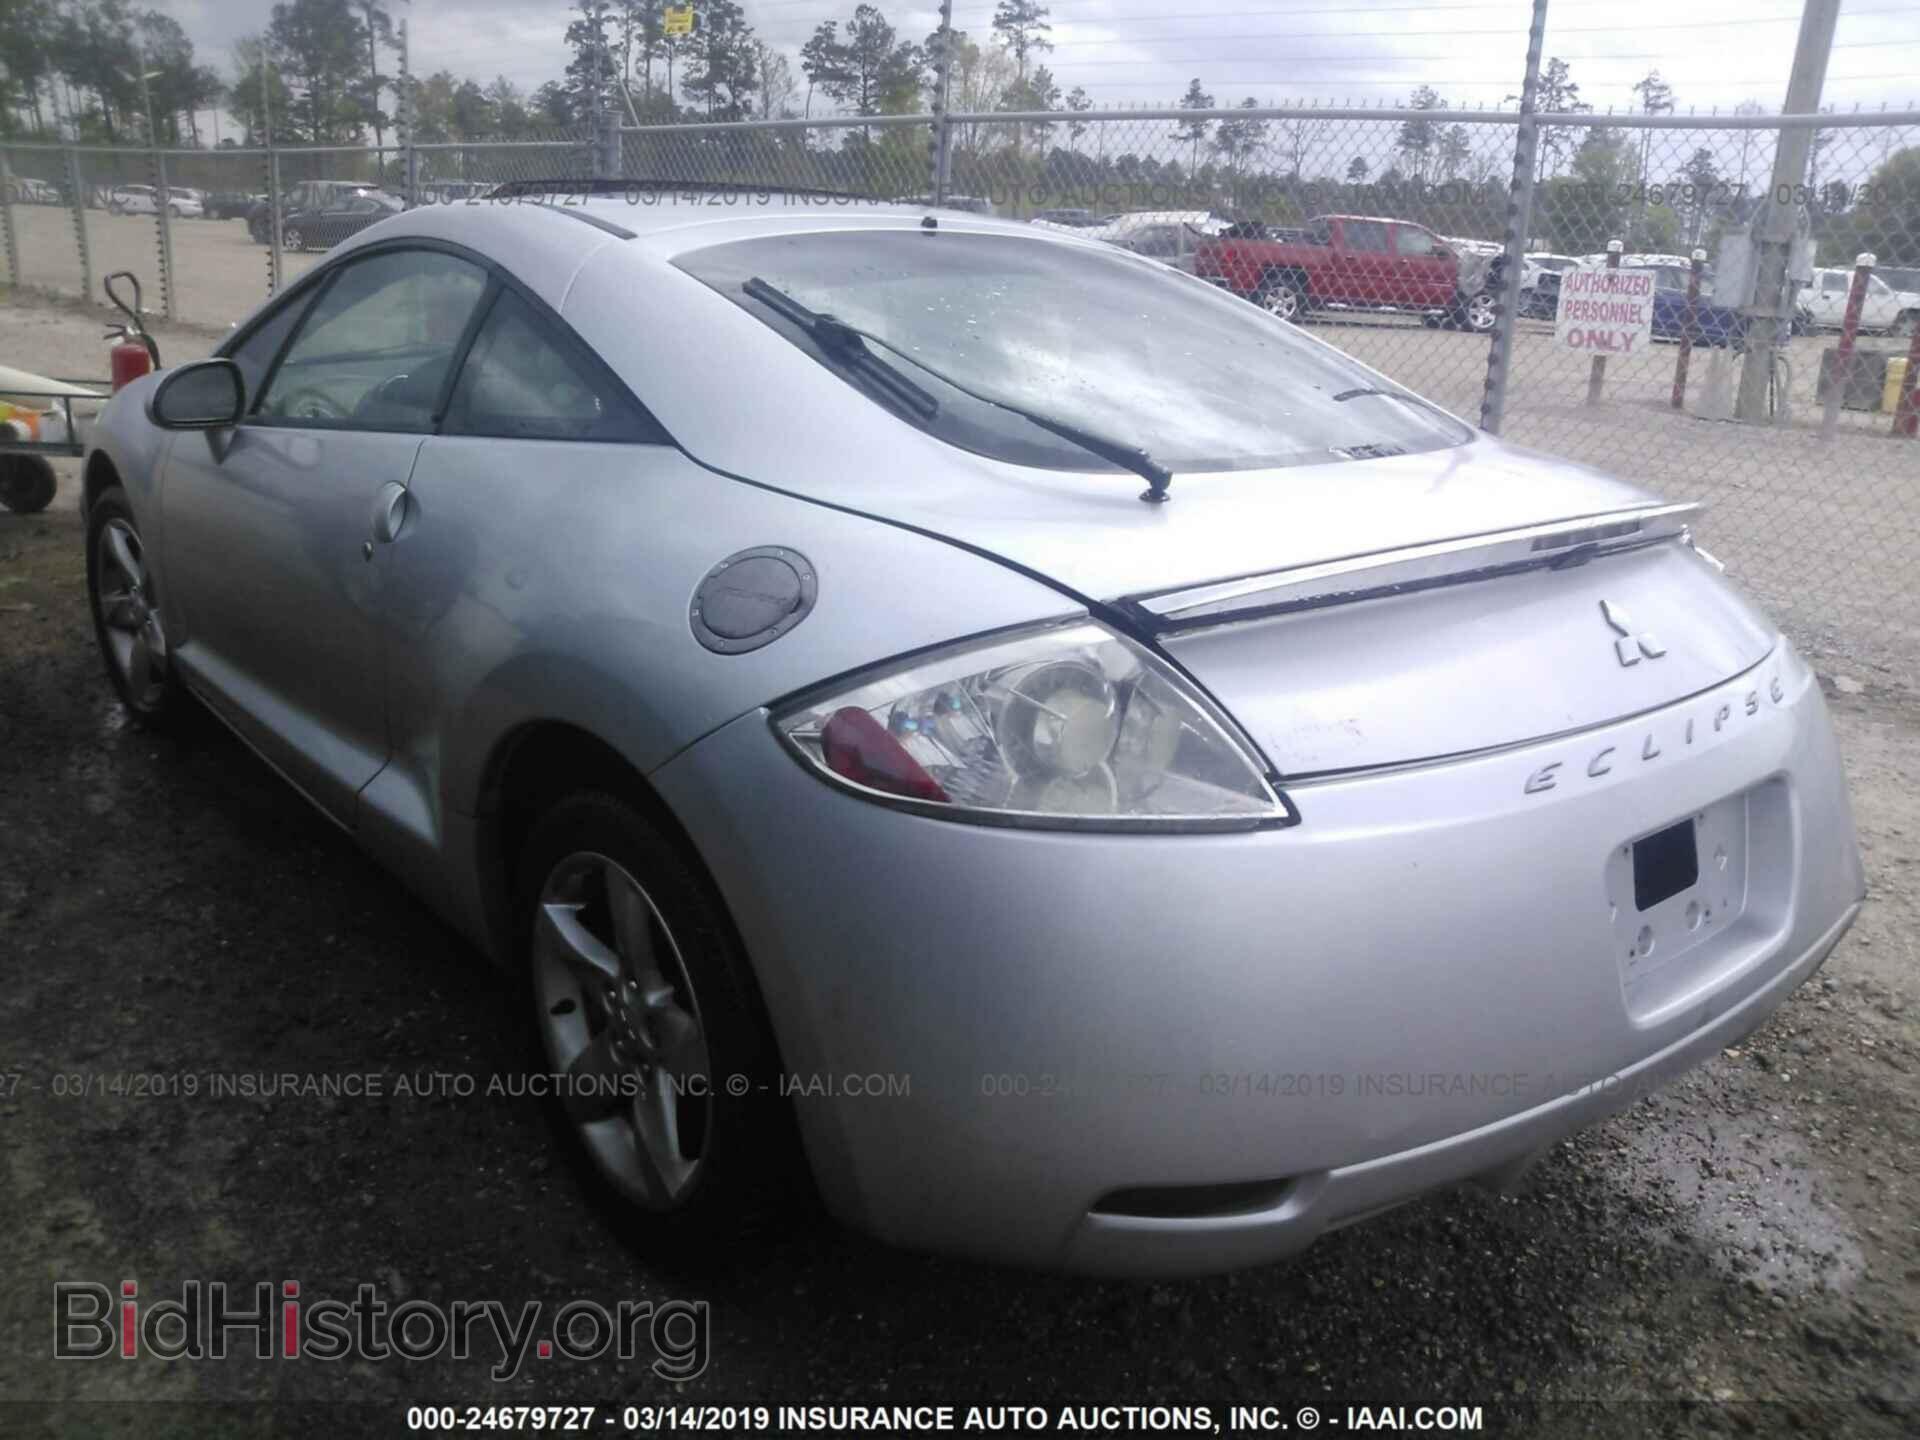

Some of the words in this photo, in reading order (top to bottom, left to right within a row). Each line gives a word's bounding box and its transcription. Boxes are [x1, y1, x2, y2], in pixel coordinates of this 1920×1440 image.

[1566, 272, 1650, 297] AUTHORIZED
[1564, 300, 1648, 324] PERSONNEL
[1566, 328, 1638, 353] ONLY
[1524, 676, 1785, 795] ECLIPSE
